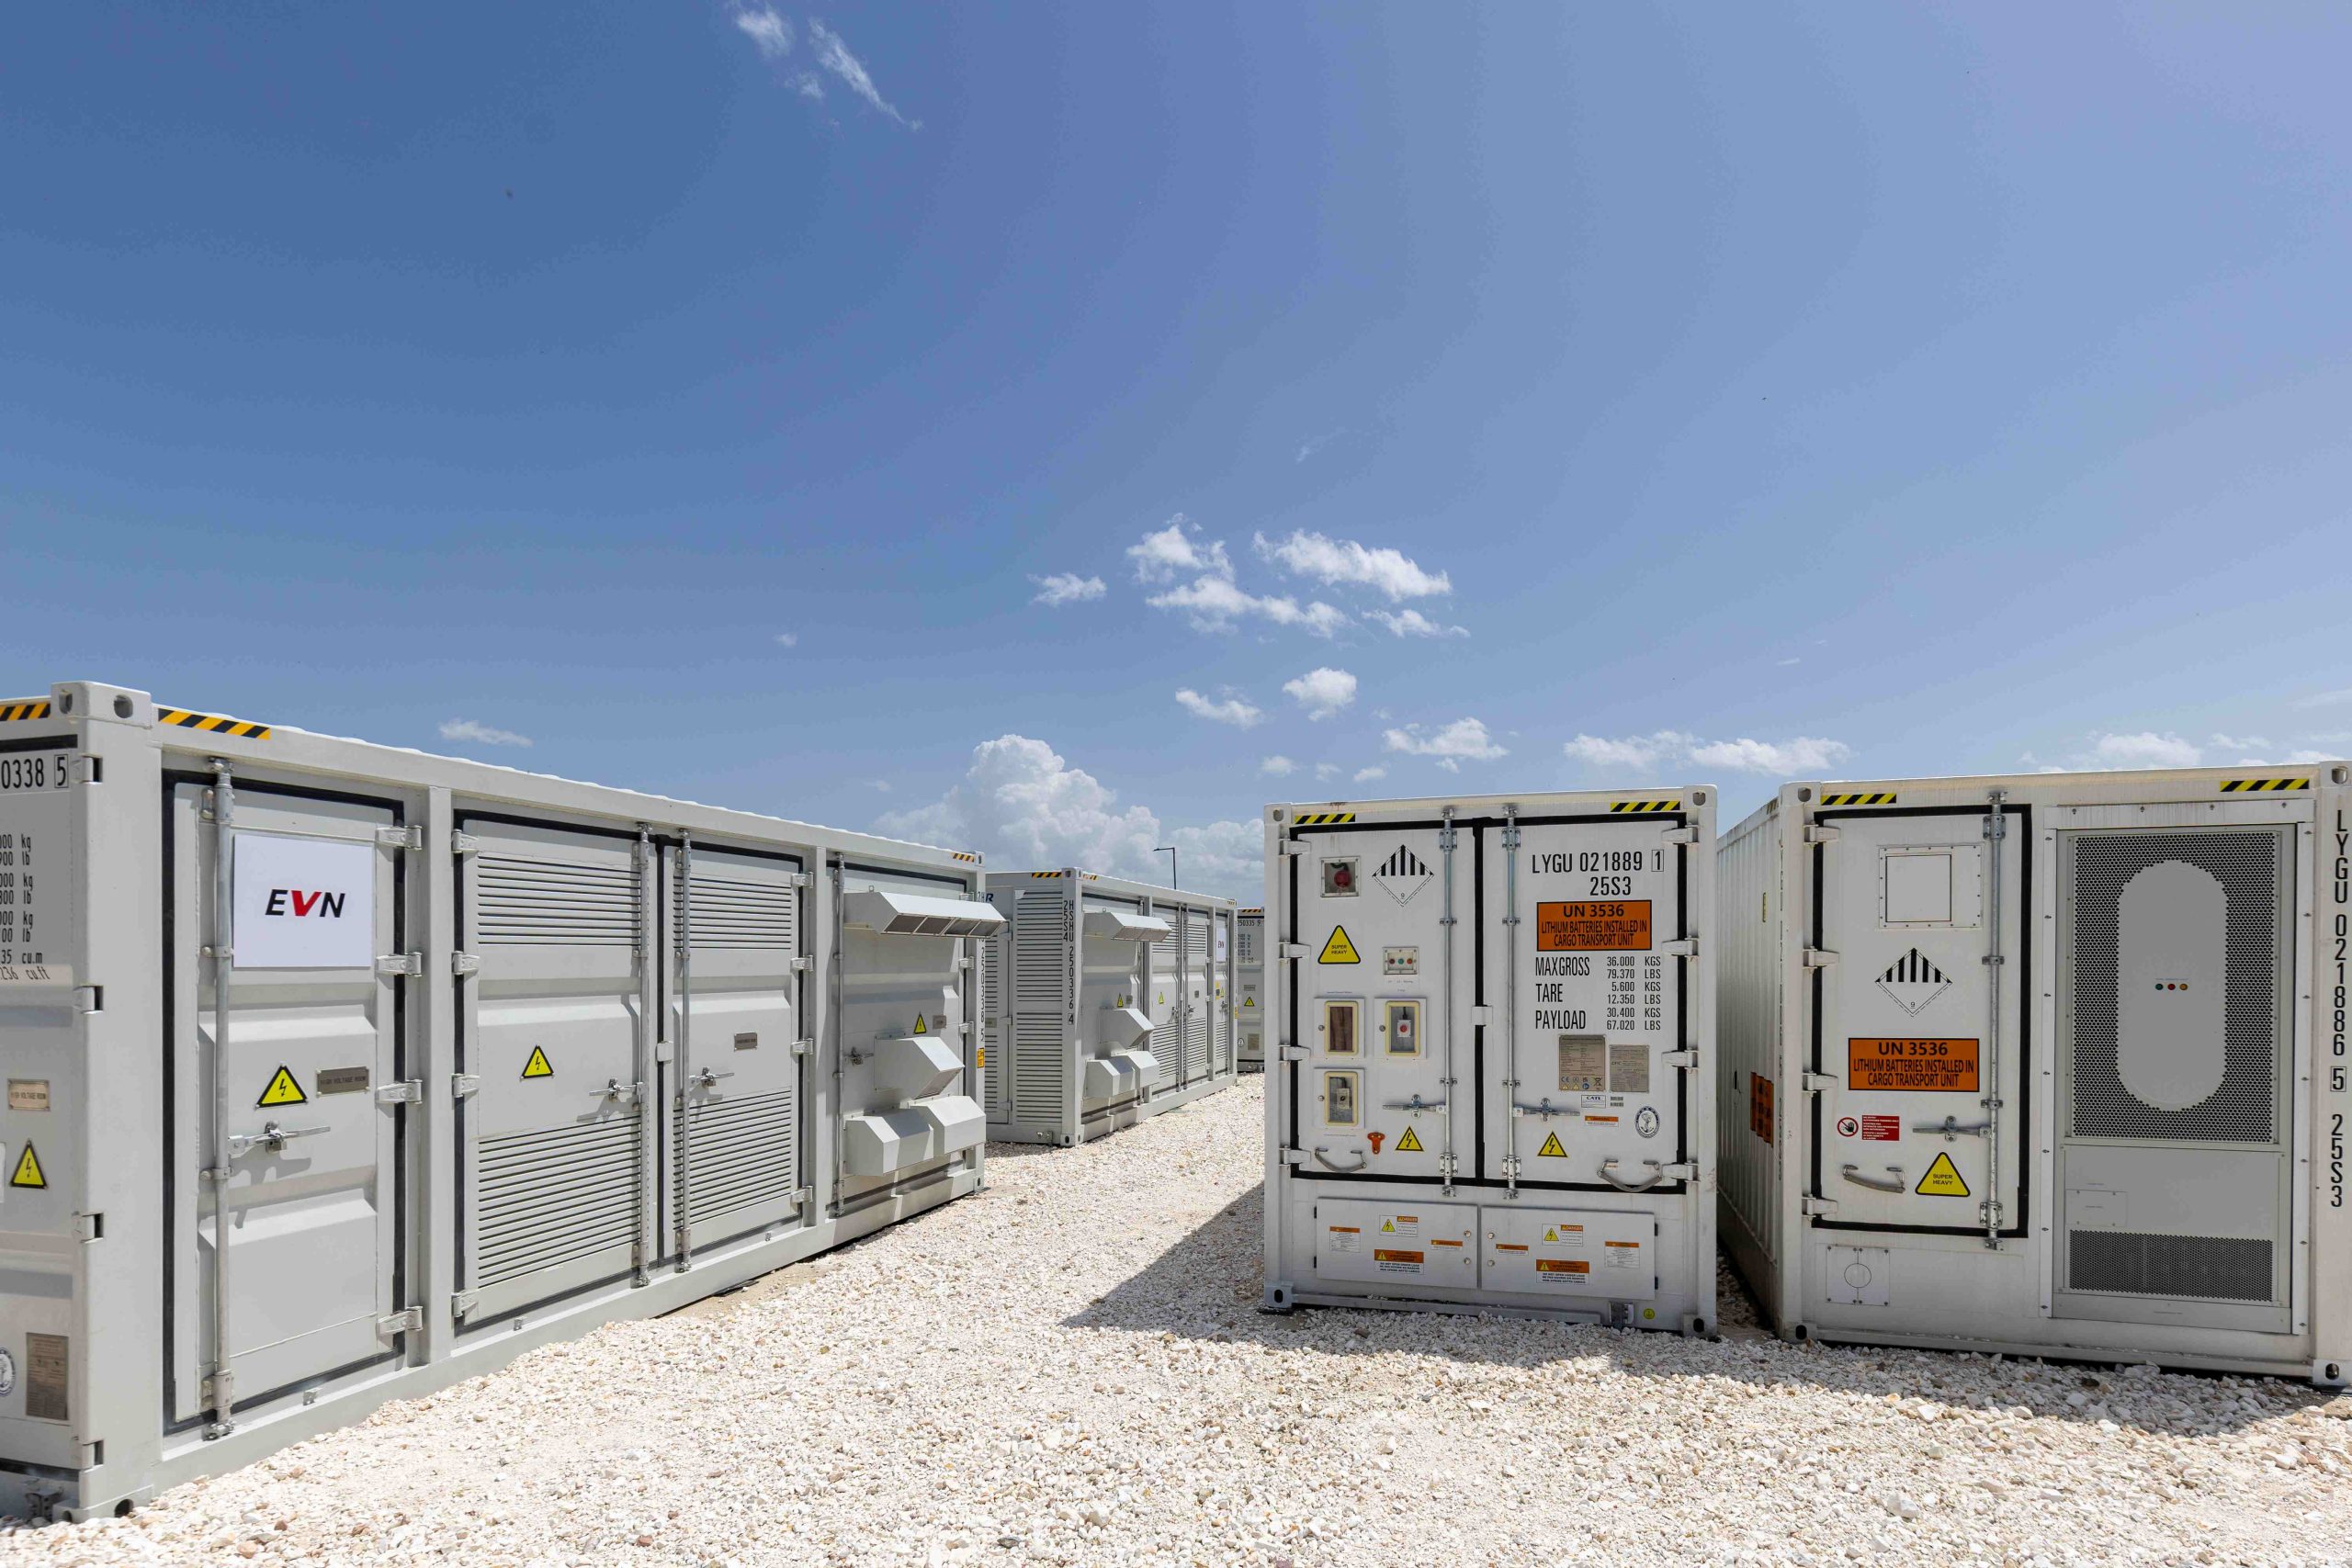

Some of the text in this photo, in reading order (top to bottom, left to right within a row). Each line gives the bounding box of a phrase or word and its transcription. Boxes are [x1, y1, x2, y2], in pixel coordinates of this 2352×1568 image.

[21, 833, 31, 852] kg
[22, 852, 30, 865] lb
[1532, 852, 1572, 874] LYGU
[1580, 852, 1643, 872] 021889
[2335, 809, 2349, 904] LYGU
[23, 873, 33, 892] kg
[1589, 876, 1631, 896] 25S3
[23, 890, 31, 904] lb
[265, 889, 345, 918] EVN
[1563, 904, 1624, 917] UN 3536
[23, 910, 33, 930] kg
[1542, 919, 1647, 933] LITHIUM BATTERIES INSTALLED IN
[23, 928, 30, 942] lb
[1554, 933, 1634, 946] CARGO TRANSPORT UNIT
[1535, 956, 1590, 976] MAXGROSS
[1645, 956, 1661, 966] KGS
[1645, 969, 1661, 979] LBS
[1645, 982, 1661, 992] KGS
[2333, 913, 2347, 1056] 021886
[1535, 983, 1564, 1002] TARE
[1645, 994, 1661, 1004] LBS
[1535, 1010, 1587, 1029] PAYLOAD
[1645, 1008, 1661, 1017] KGS
[1645, 1021, 1661, 1030] LBS
[1878, 1042, 1949, 1055] UN 3536
[1853, 1058, 1974, 1073] LITHIUM BATTERIES INSTALLED IN
[1868, 1073, 1959, 1087] CARGO TRANSPORT UNIT
[2330, 1113, 2343, 1208] 25S3
